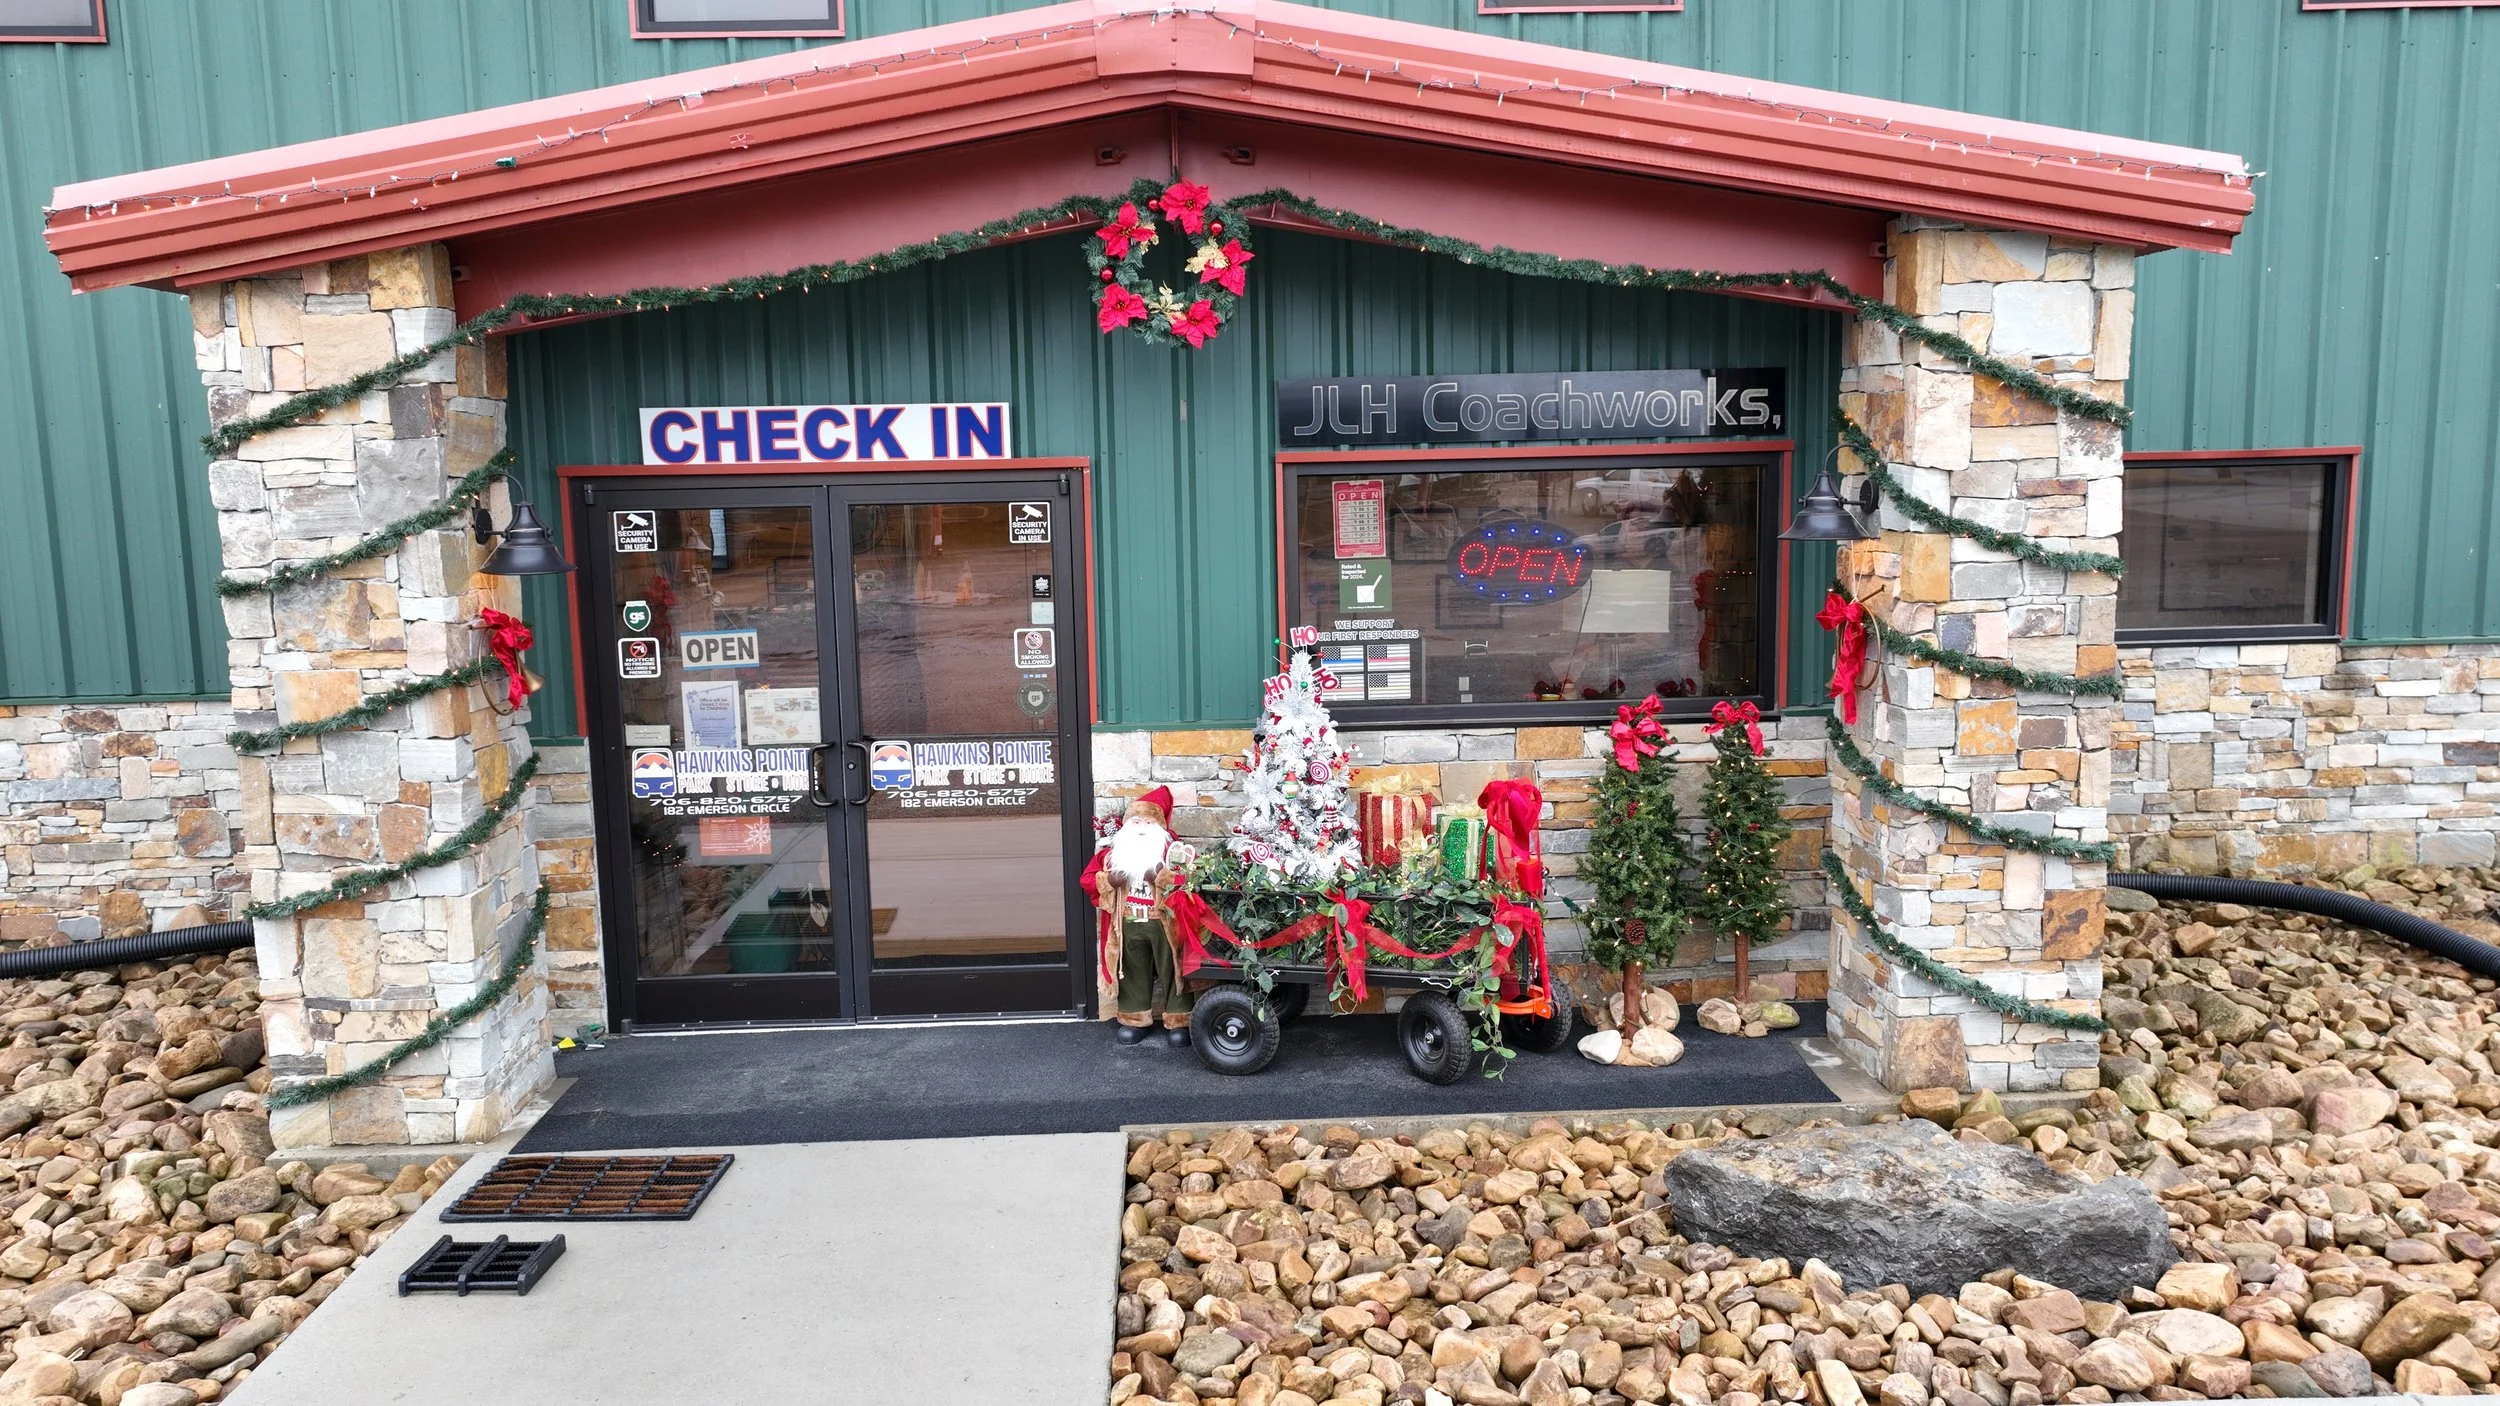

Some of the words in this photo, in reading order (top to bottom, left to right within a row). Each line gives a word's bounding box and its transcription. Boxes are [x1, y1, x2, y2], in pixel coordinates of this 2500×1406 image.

[1294, 384, 1397, 436] JLH
[649, 407, 908, 464] CHECK
[930, 406, 1005, 459] IN
[1338, 491, 1379, 501] OPEN
[1459, 542, 1583, 586] OPEN
[629, 611, 646, 624] gs
[1335, 620, 1351, 629] WE
[1352, 619, 1394, 629] SUPPORT
[1290, 625, 1318, 648] HO
[1317, 631, 1331, 641] UR
[1332, 630, 1358, 641] FIRST
[1359, 629, 1419, 640] RESPONDERS
[686, 636, 755, 663] OPEN
[1263, 673, 1293, 697] HO
[1311, 667, 1338, 690] HO
[676, 751, 751, 775] HAWKINS
[914, 744, 988, 768] HAWKINS
[994, 741, 1052, 766] POINTE
[677, 776, 713, 794] PARK
[726, 774, 769, 792] STORE
[782, 774, 818, 791] MOR
[915, 769, 950, 786] PARK
[963, 768, 1006, 785] STORE
[1019, 767, 1054, 784] MORE
[650, 796, 803, 807] 706-820-6757
[887, 788, 1039, 799] 706-820-6757
[901, 799, 921, 808] 182
[924, 798, 983, 807] EMERSON
[987, 796, 1026, 806] CIRCLE
[664, 805, 684, 816] 182
[687, 803, 747, 814] EMERSON
[750, 802, 790, 813] CIRCLE
